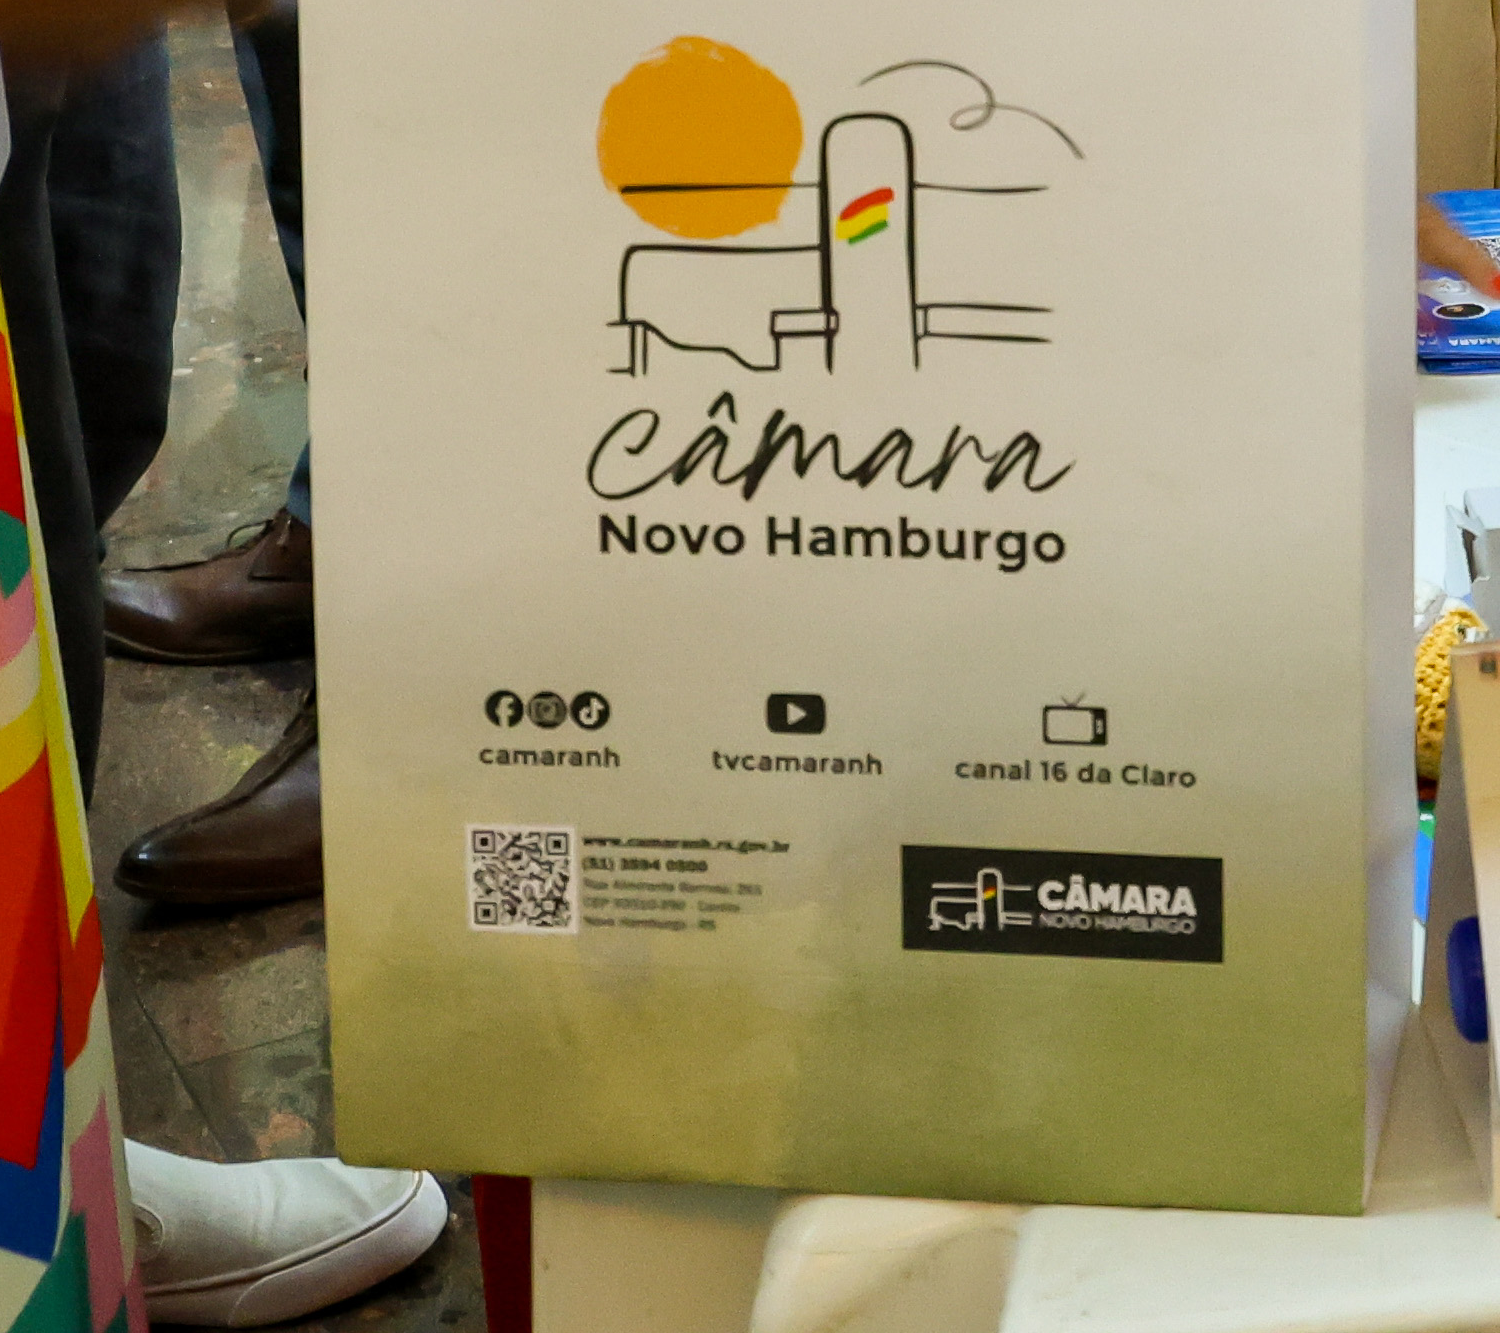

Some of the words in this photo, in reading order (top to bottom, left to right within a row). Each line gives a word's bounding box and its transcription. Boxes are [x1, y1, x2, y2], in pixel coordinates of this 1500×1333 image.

[599, 514, 745, 556] Novo
[765, 515, 1067, 573] Hamburgo
[478, 746, 621, 768] camaranh
[711, 748, 883, 776] tvcamaranh
[954, 759, 1031, 781] canal
[1041, 761, 1068, 782] 16
[1076, 762, 1112, 784] da
[1121, 764, 1197, 788] Claro
[1036, 872, 1198, 918] CÂMARA
[1038, 913, 1094, 930] NOVO
